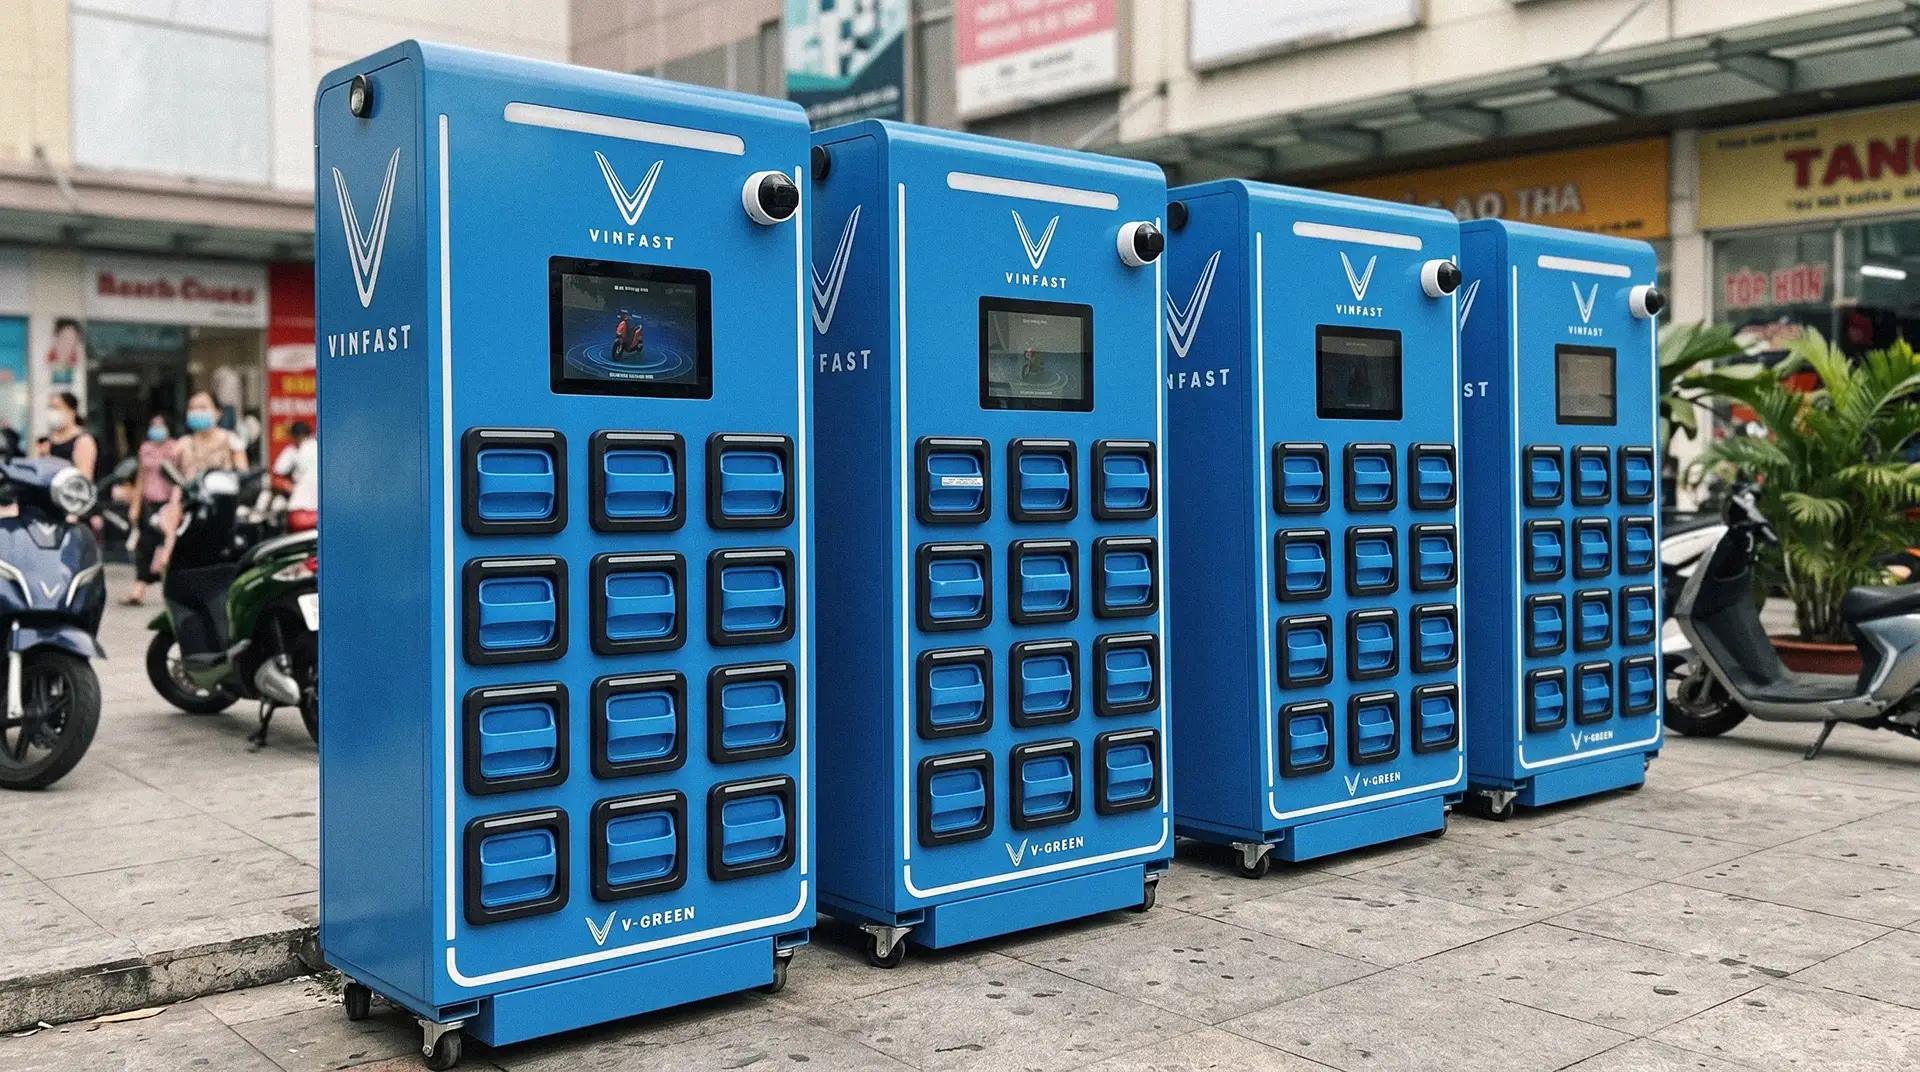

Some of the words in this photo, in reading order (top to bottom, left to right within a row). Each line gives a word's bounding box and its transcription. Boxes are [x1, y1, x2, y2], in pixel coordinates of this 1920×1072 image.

[1784, 133, 1920, 189] TAN
[588, 228, 674, 250] VINFAST
[1005, 271, 1067, 289] VINFAST
[1335, 303, 1384, 318] VINFAST
[328, 324, 411, 358] VINFAST
[1567, 325, 1604, 337] VINFAST
[813, 349, 871, 373] FAST
[1583, 730, 1614, 743] V-GREEN
[1362, 771, 1401, 787] V-GREEN
[1030, 836, 1084, 856] V-GREEN
[621, 905, 696, 932] V-GREEN
